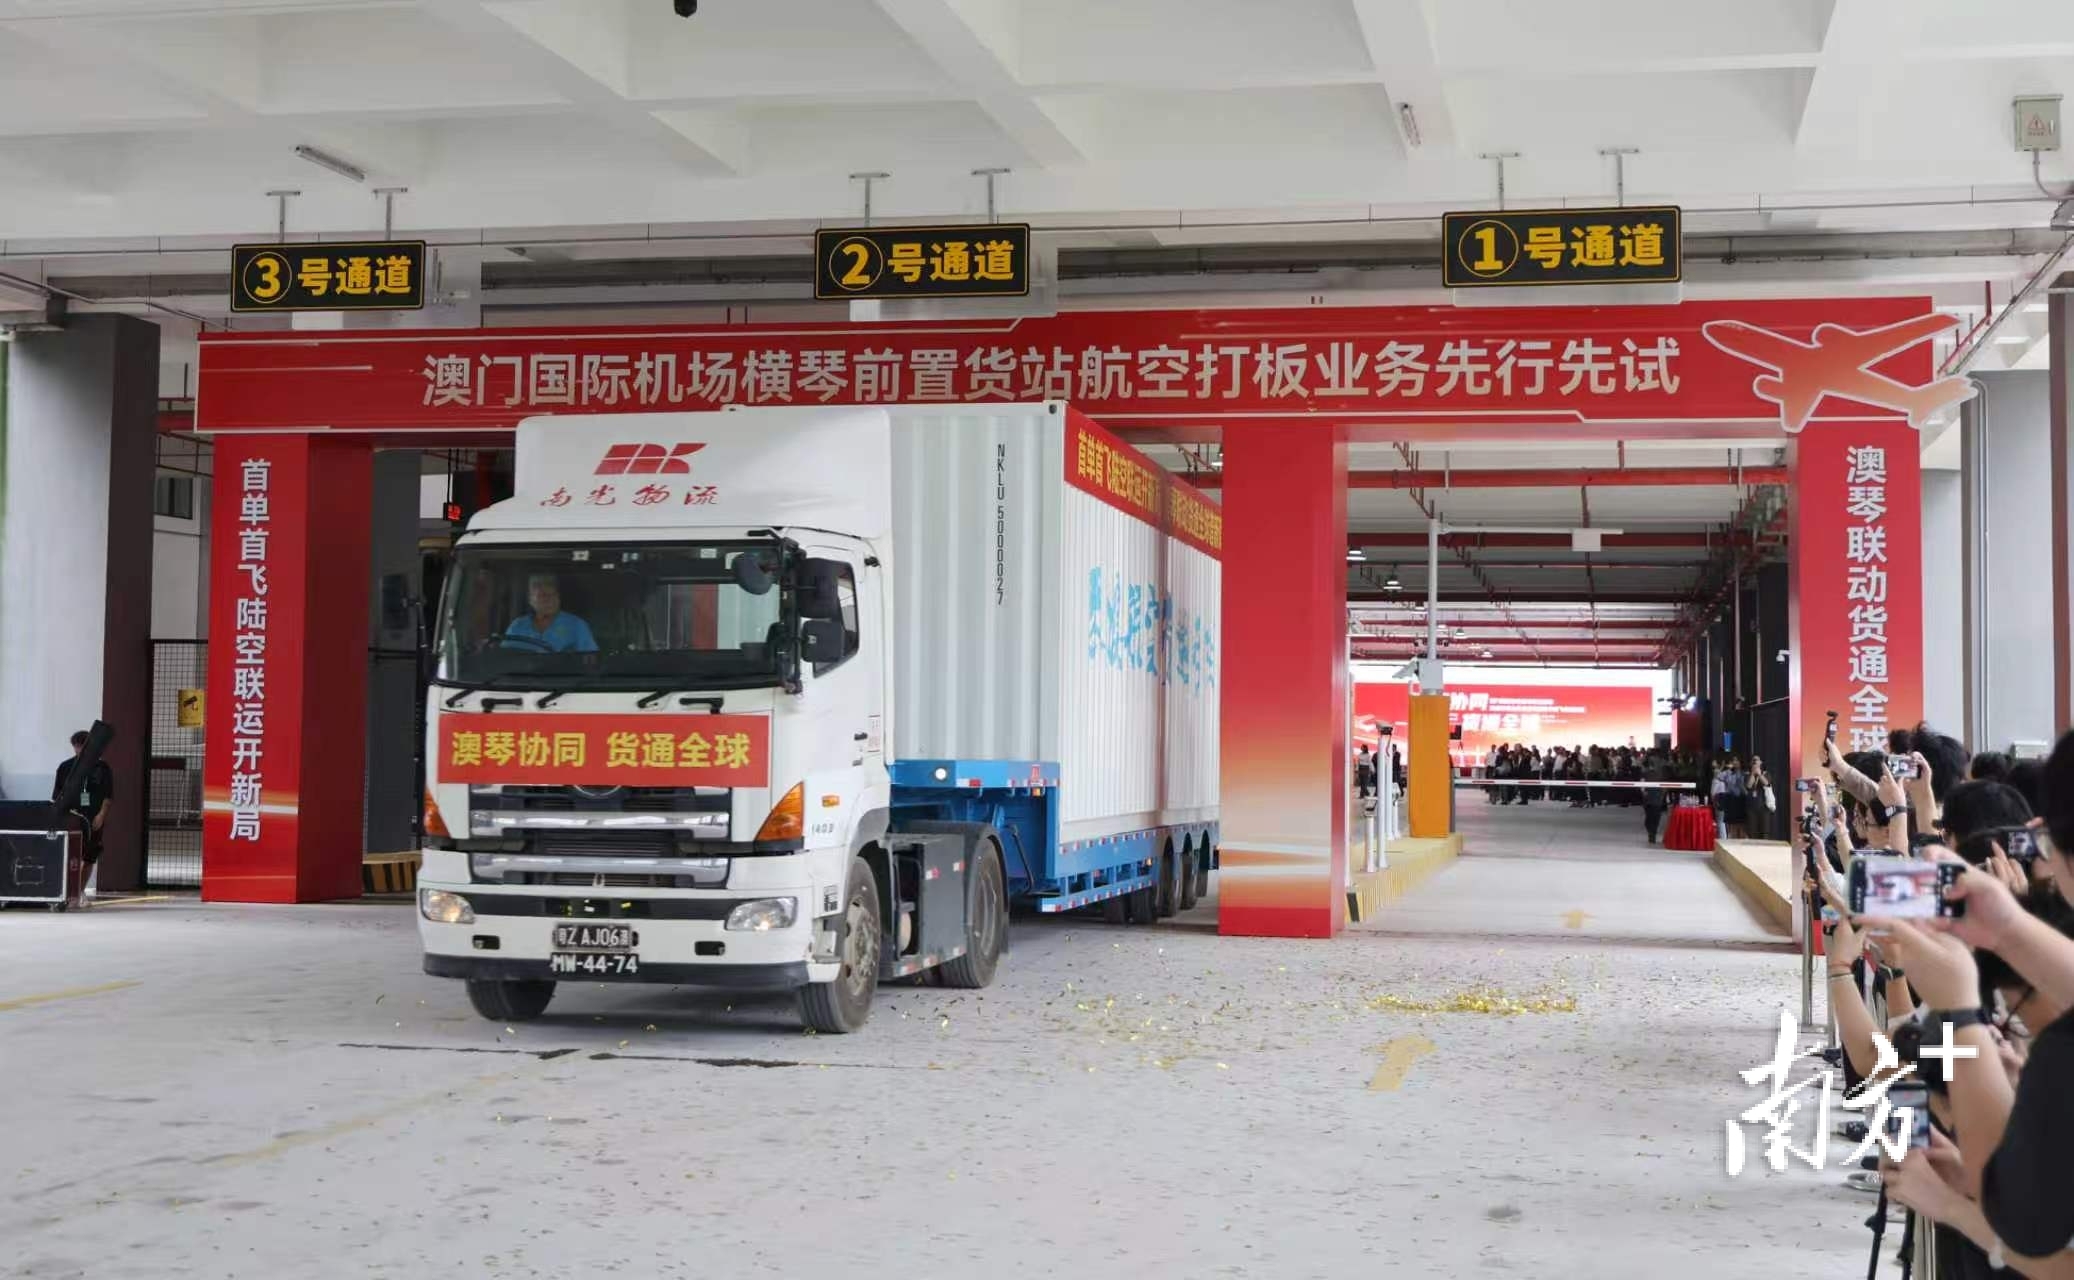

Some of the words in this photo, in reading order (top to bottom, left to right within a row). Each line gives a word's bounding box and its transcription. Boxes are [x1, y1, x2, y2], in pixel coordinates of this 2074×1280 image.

[422, 336, 1681, 406] 澳门国际机场横琴前置货站航空打板业务先行先试
[997, 443, 1005, 500] NKLU
[1078, 428, 1164, 517] 首单首飞陆空联运开新
[1847, 446, 1888, 753] 澳琴联动货通全球
[229, 458, 271, 842] 首单首飞陆空联运开新局
[452, 731, 586, 768] 澳琴协同
[606, 732, 751, 769] 货通全球
